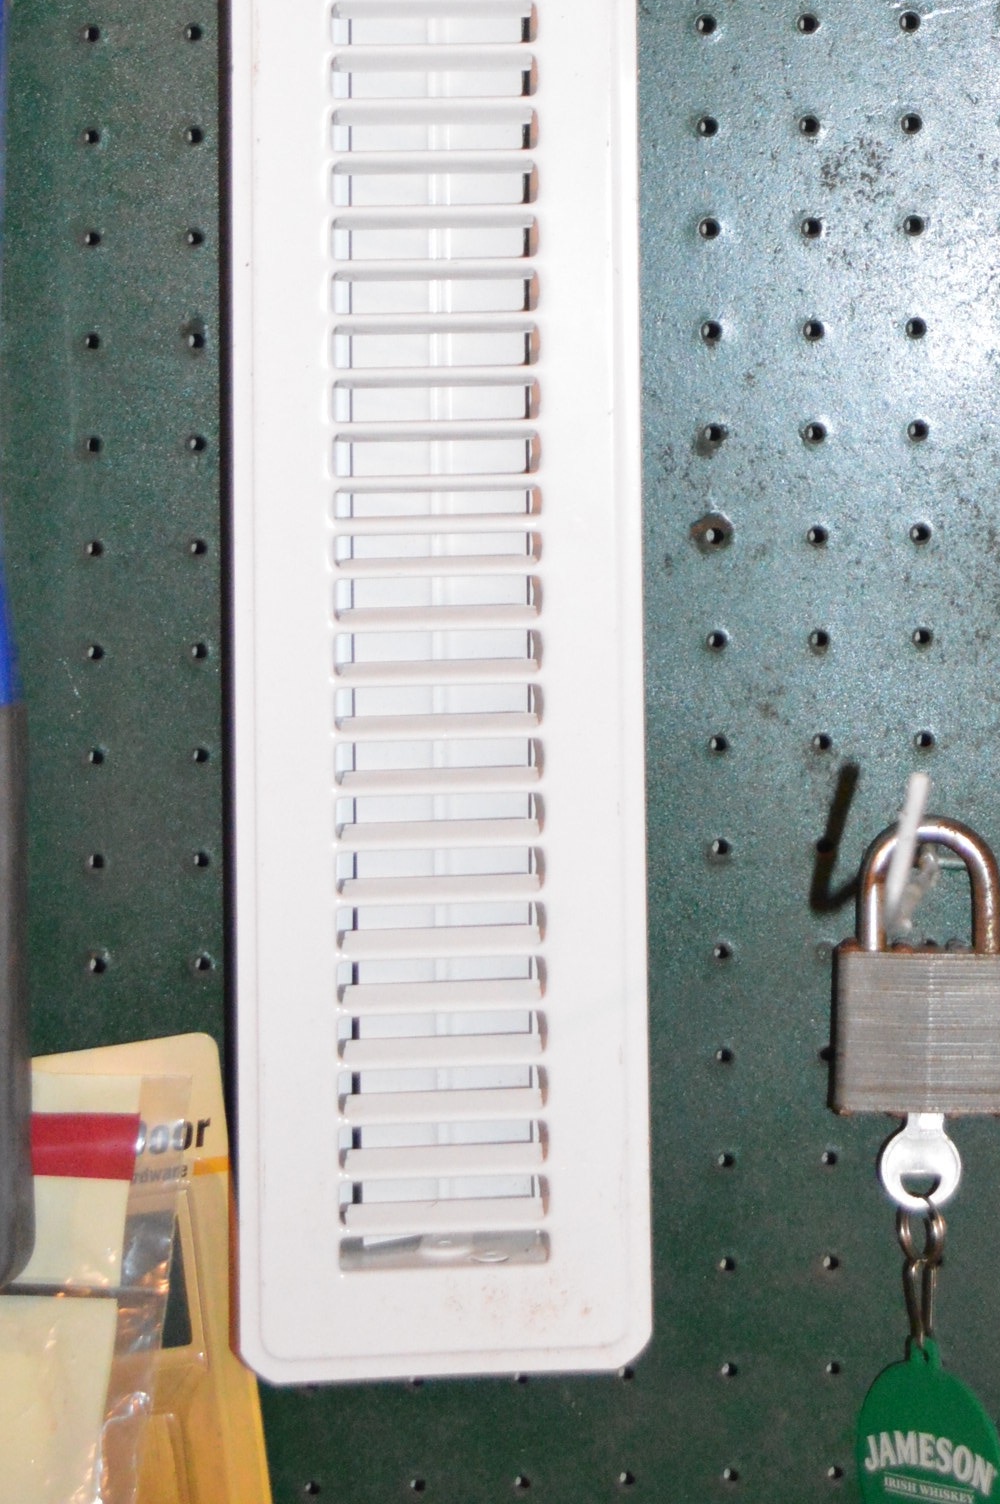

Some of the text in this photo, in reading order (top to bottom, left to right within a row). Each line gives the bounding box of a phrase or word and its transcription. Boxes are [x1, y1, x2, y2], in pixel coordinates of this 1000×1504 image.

[865, 1430, 994, 1496] JAMESON
[884, 1476, 974, 1504] IRISH WHISKEY
